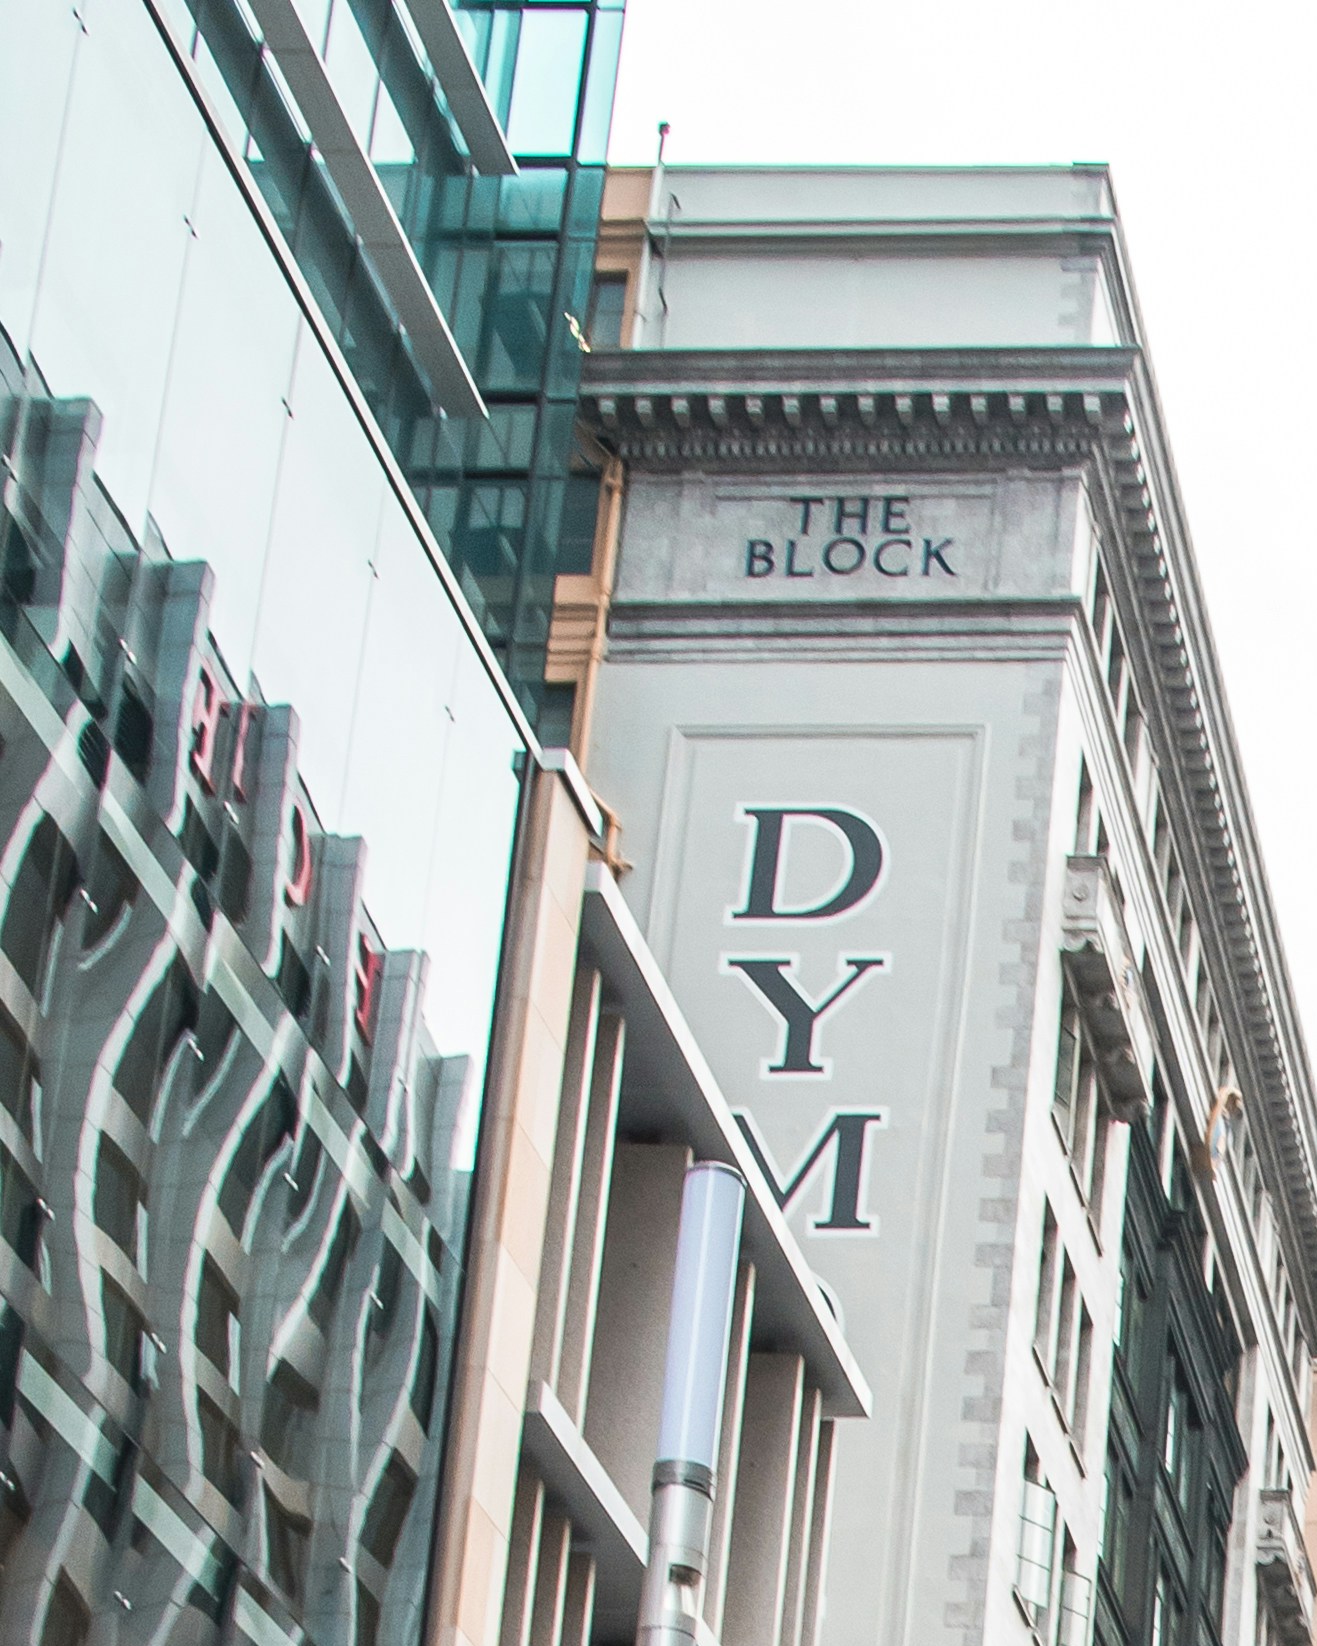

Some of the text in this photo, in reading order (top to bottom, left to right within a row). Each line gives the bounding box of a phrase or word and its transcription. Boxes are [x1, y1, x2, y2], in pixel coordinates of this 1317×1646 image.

[789, 495, 912, 536] THE
[745, 536, 958, 578] BLOCK
[727, 806, 883, 1320] DYM
